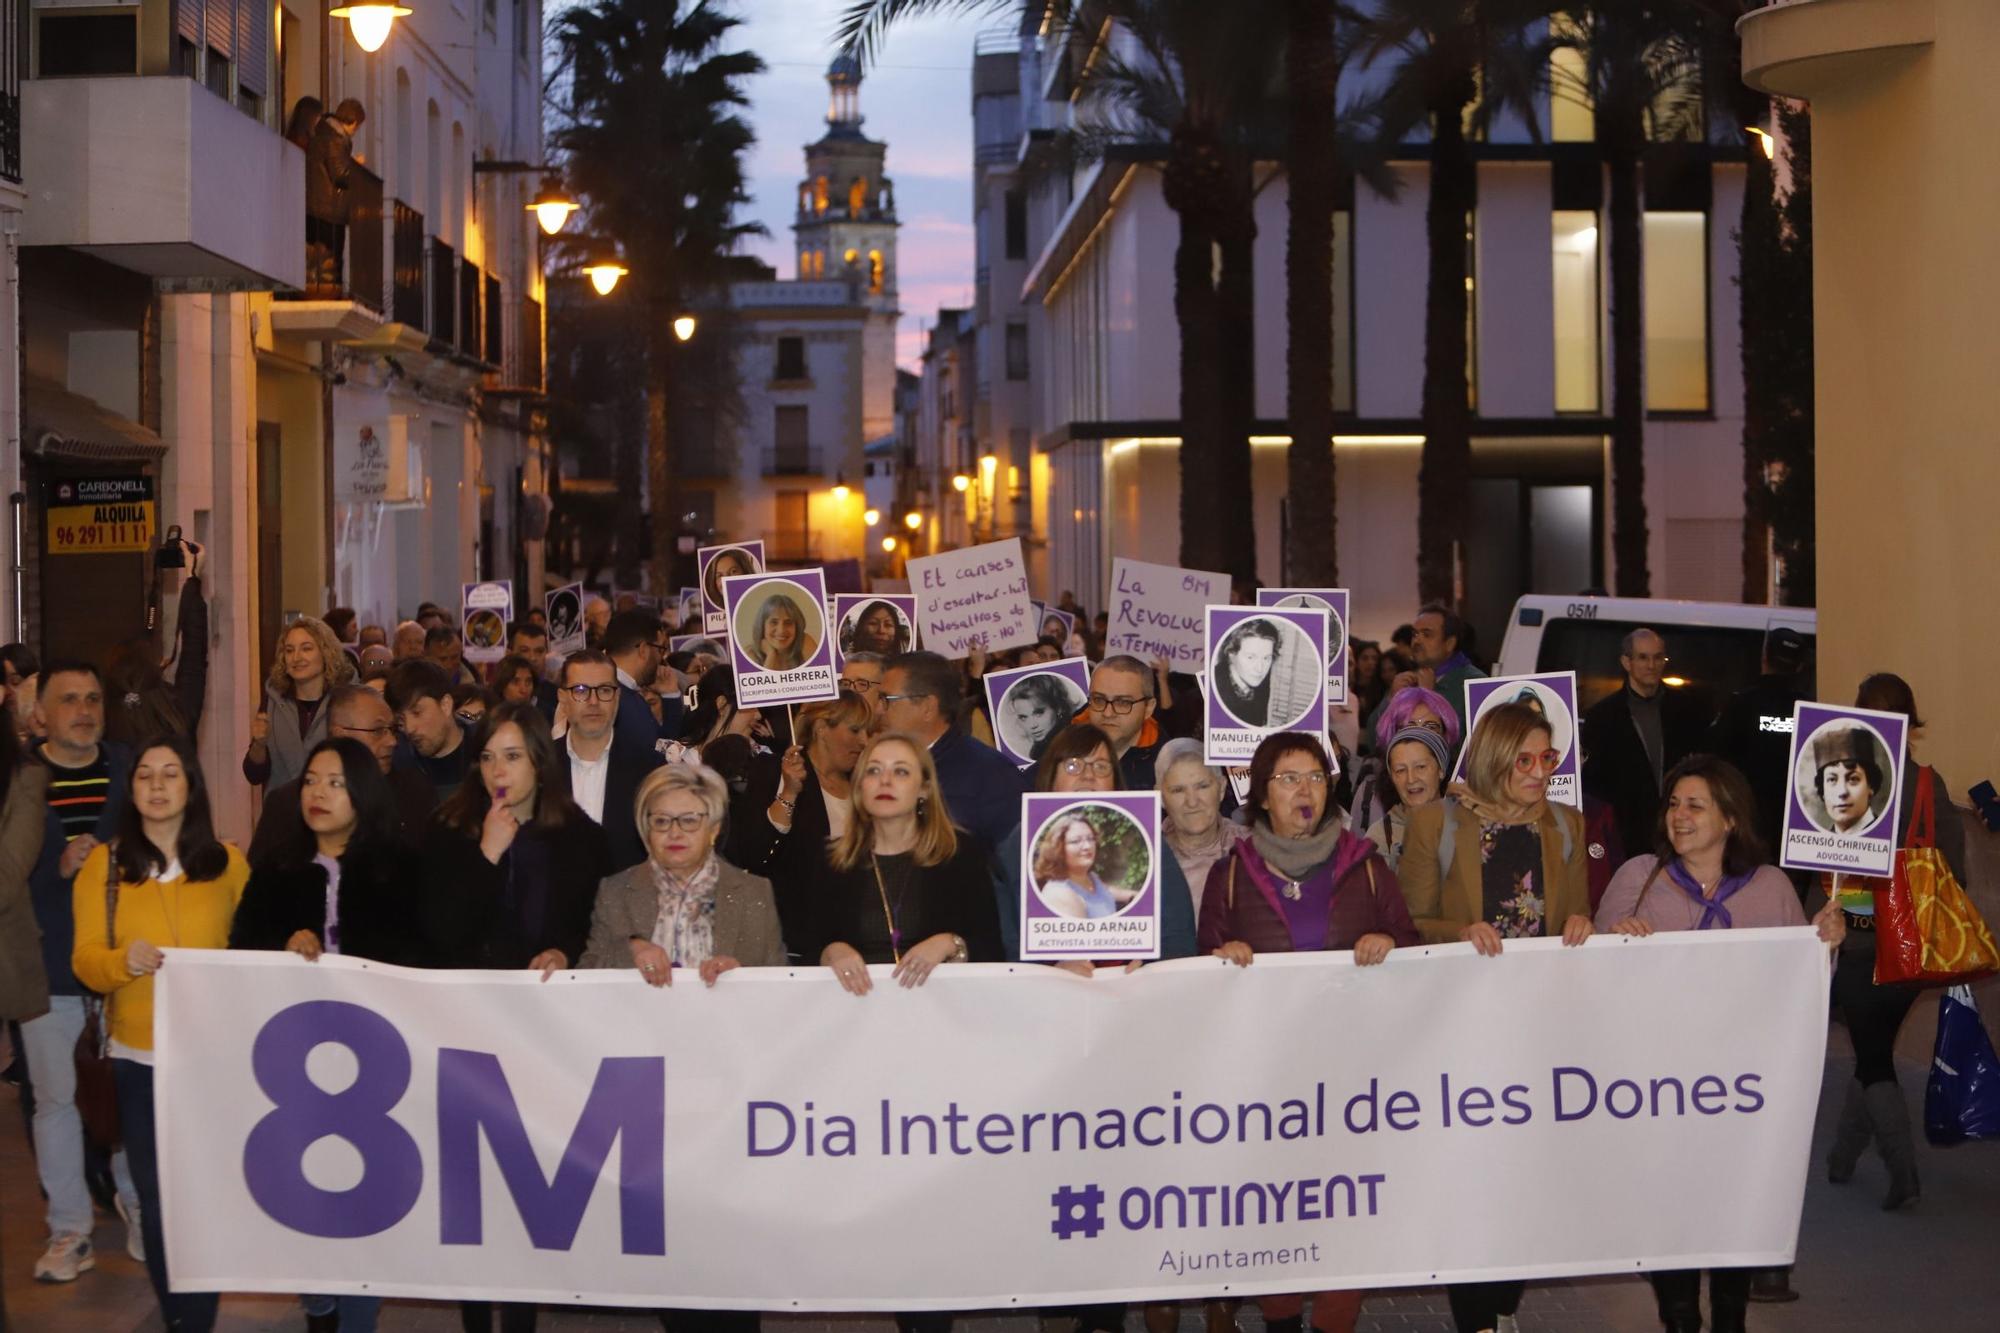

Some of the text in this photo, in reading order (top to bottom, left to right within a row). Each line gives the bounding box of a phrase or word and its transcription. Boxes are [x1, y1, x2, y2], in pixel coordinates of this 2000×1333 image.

[78, 481, 145, 492] CARBONELL
[94, 504, 146, 524] ALQUILA
[57, 524, 147, 545] 96 291 11 11
[923, 558, 1014, 589] Et canses
[1117, 568, 1210, 597] La 8M
[1567, 603, 1598, 619] 05M
[741, 670, 829, 687] CORAL HERRERA
[1211, 733, 1262, 743] MANUELA
[1789, 834, 1889, 854] ASCENSIÓ CHIRIVELLA
[1816, 851, 1860, 863] ADVOCADA
[1033, 921, 1148, 933] SOLEDAD ARNAU
[1038, 938, 1085, 947] ACTIVISTA
[747, 1066, 1765, 1157] Dia Internacional de les Dones
[243, 1000, 666, 1257] 8M
[1159, 1242, 1321, 1276] Ajuntament
